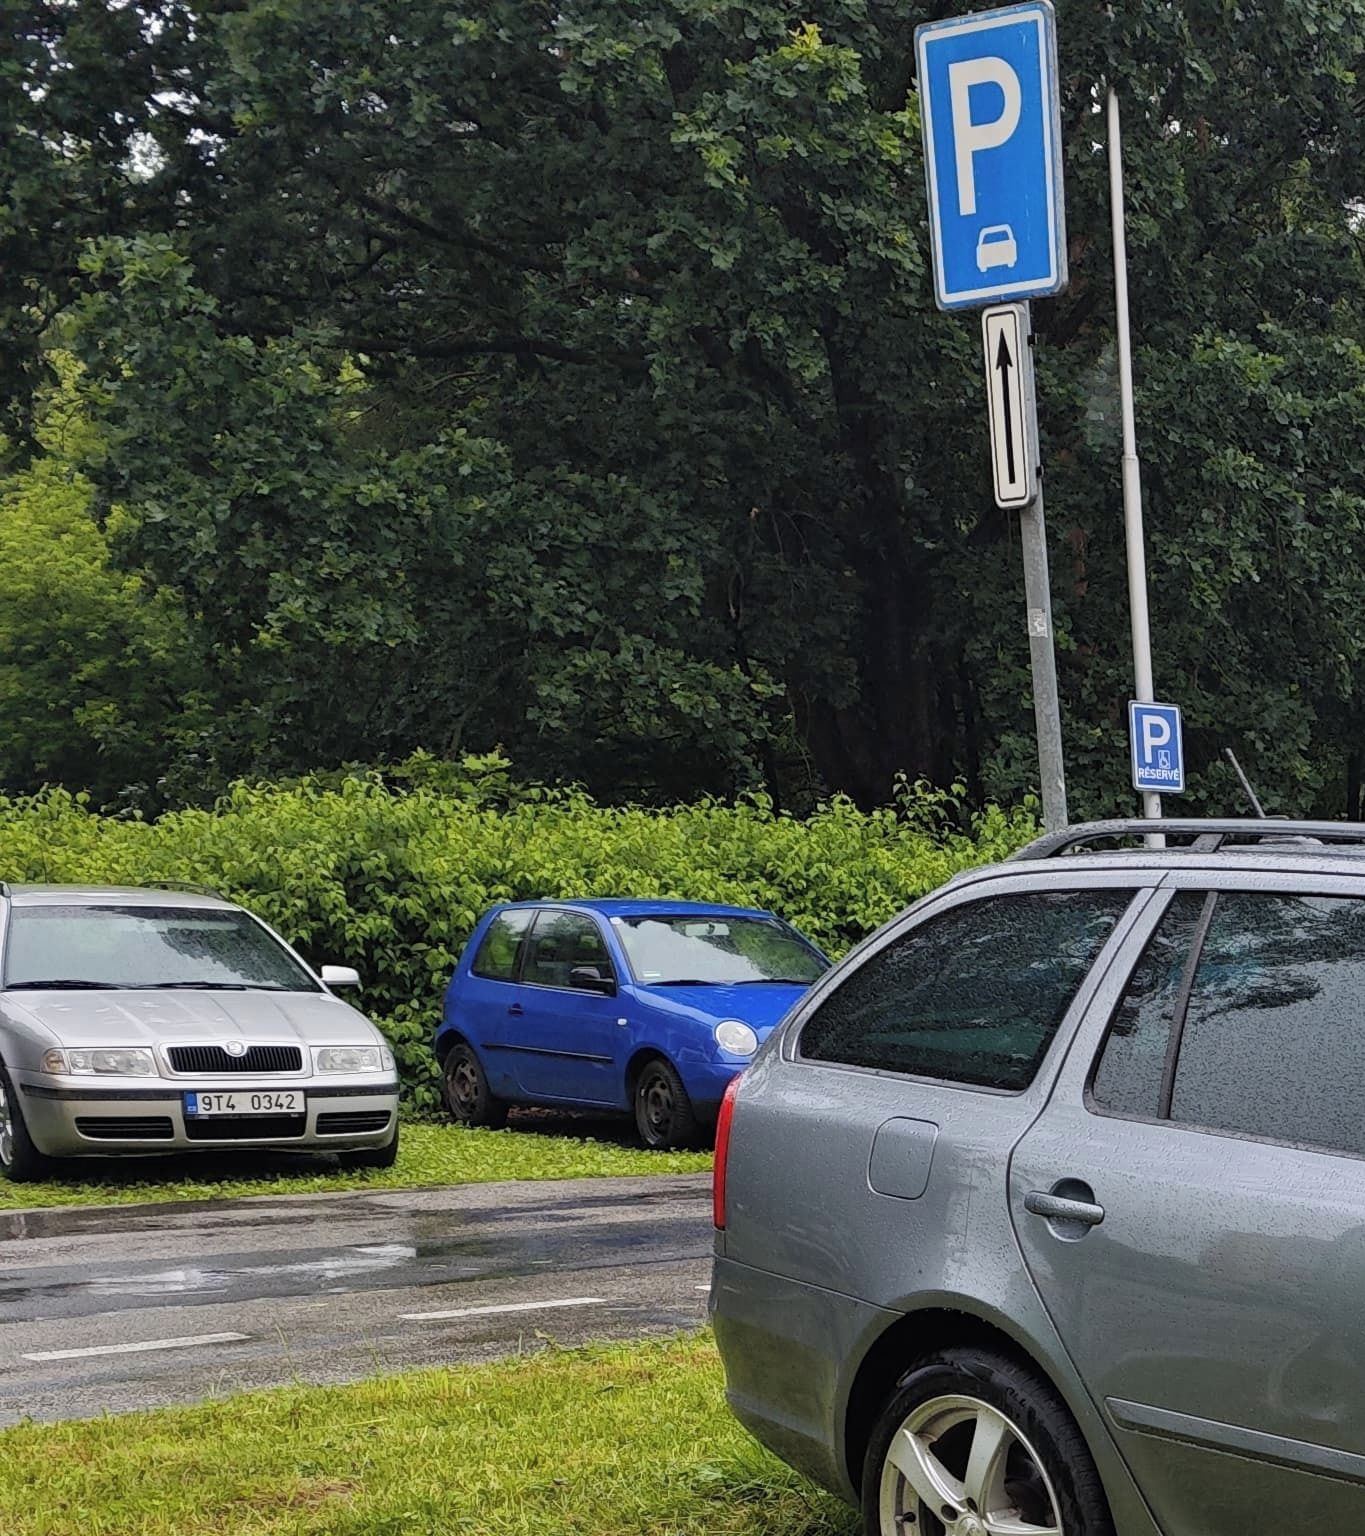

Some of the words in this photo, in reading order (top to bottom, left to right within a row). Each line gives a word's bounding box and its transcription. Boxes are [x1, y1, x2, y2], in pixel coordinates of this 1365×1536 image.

[948, 56, 1022, 216] P
[1142, 714, 1171, 764] P
[1138, 766, 1180, 780] RÉSERVÉ
[202, 1095, 237, 1112] 9T4
[251, 1094, 296, 1111] 0342
